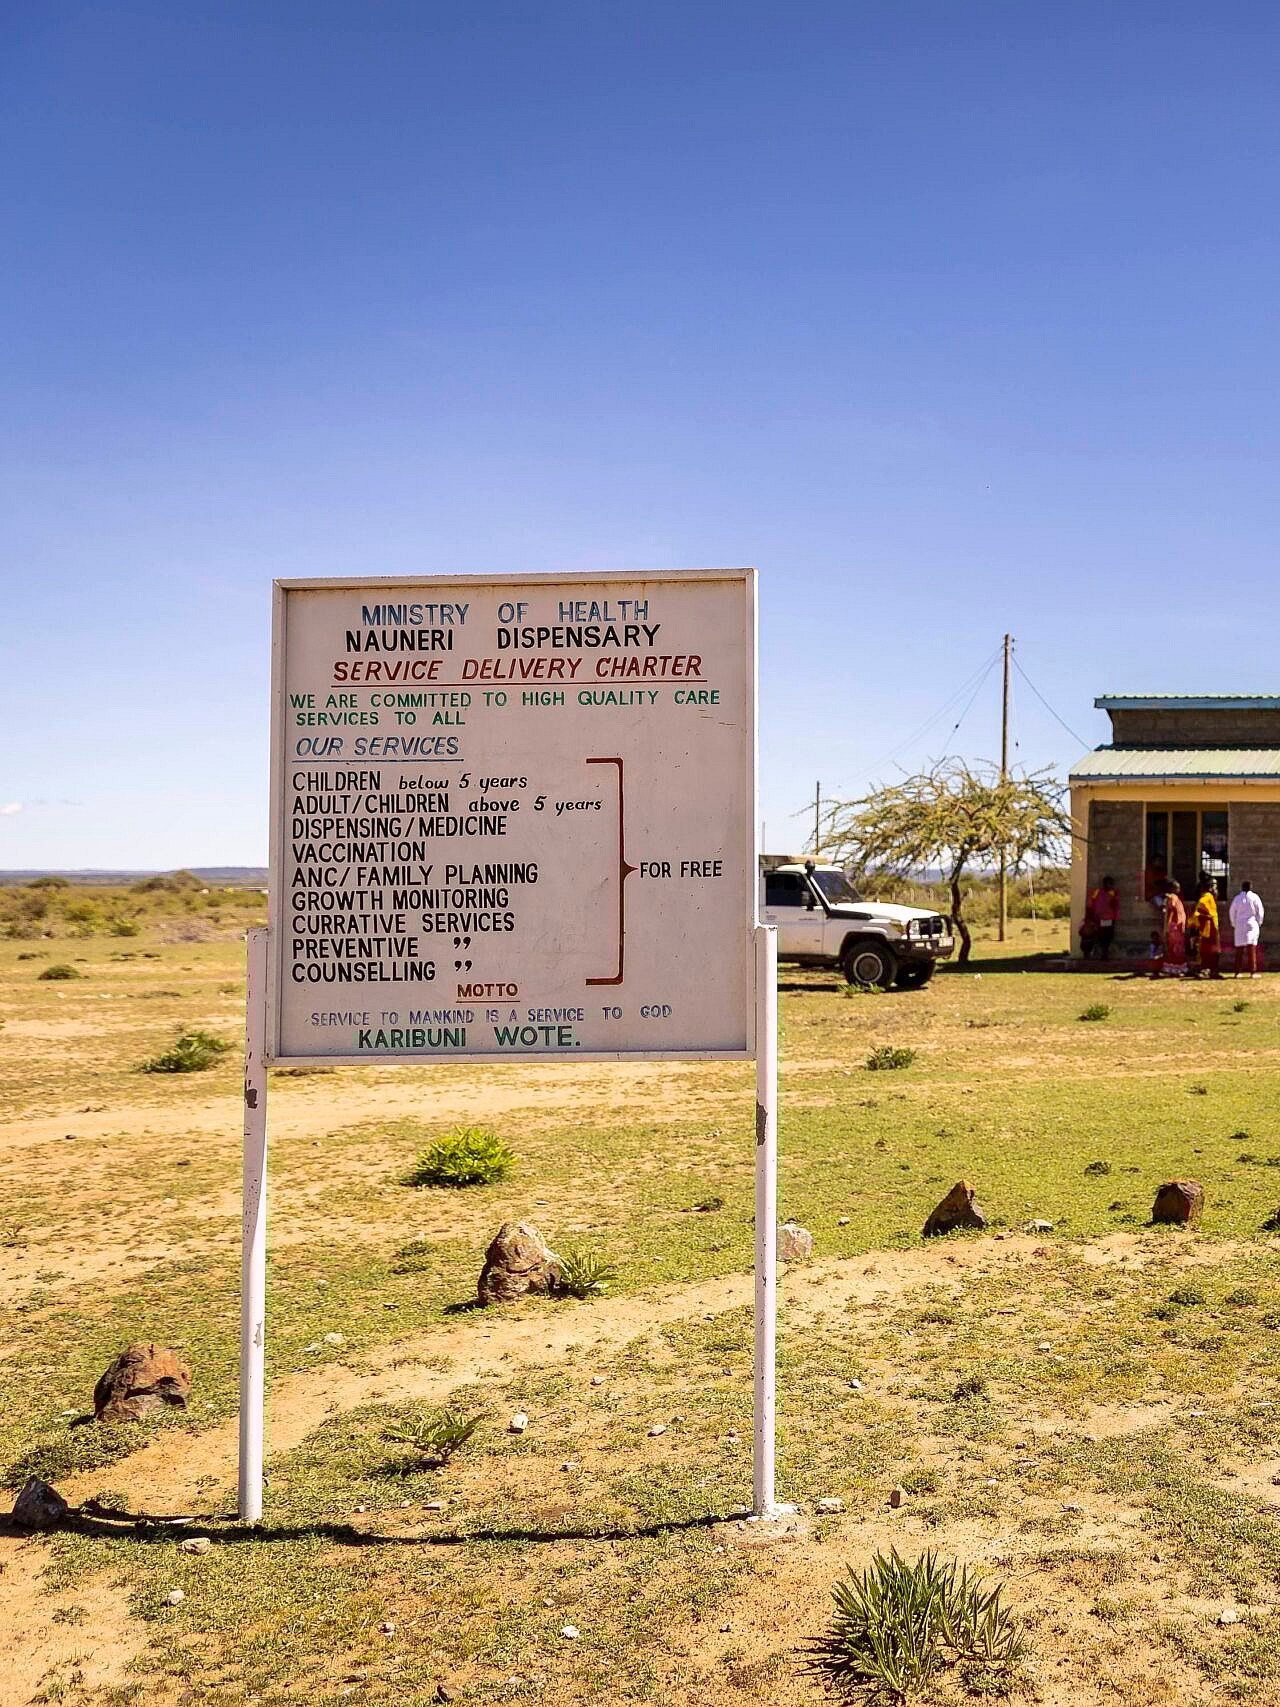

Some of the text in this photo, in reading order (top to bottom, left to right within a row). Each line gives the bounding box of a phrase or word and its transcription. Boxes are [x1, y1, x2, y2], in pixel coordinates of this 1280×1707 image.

[361, 600, 649, 627] MINISTRY OF HEALTH
[345, 624, 661, 653] NAUNERI DISPENSARY
[333, 655, 702, 682] SERVICE DELIVERY CHARTER
[290, 689, 721, 709] WE ARE COMMITTED TO HIGH QUALITY CARE
[295, 710, 466, 727] SERVICES TO ALL
[296, 736, 459, 757] OUR SERVICES
[292, 770, 528, 794] CHILDREN below 5 years
[292, 792, 604, 817] ADULT/CHILDREN above 5 years
[292, 815, 508, 840] DISPENSING/MEDICINE
[291, 841, 426, 864] VACCINATION
[445, 862, 539, 886] PLANNING
[639, 859, 723, 879] FOR FREE
[291, 887, 509, 912] GROWTH MONITORING
[292, 911, 515, 935] CURRATIVE SERVICES
[292, 936, 419, 960] PREVENTIVE
[291, 960, 436, 984] COUNSELLING
[457, 982, 519, 999] MOTTO
[311, 1004, 673, 1027] SERVICE TO MANKIND IS A SERVICE TO GOD
[358, 1025, 581, 1049] KARIBUNI WOTE.
